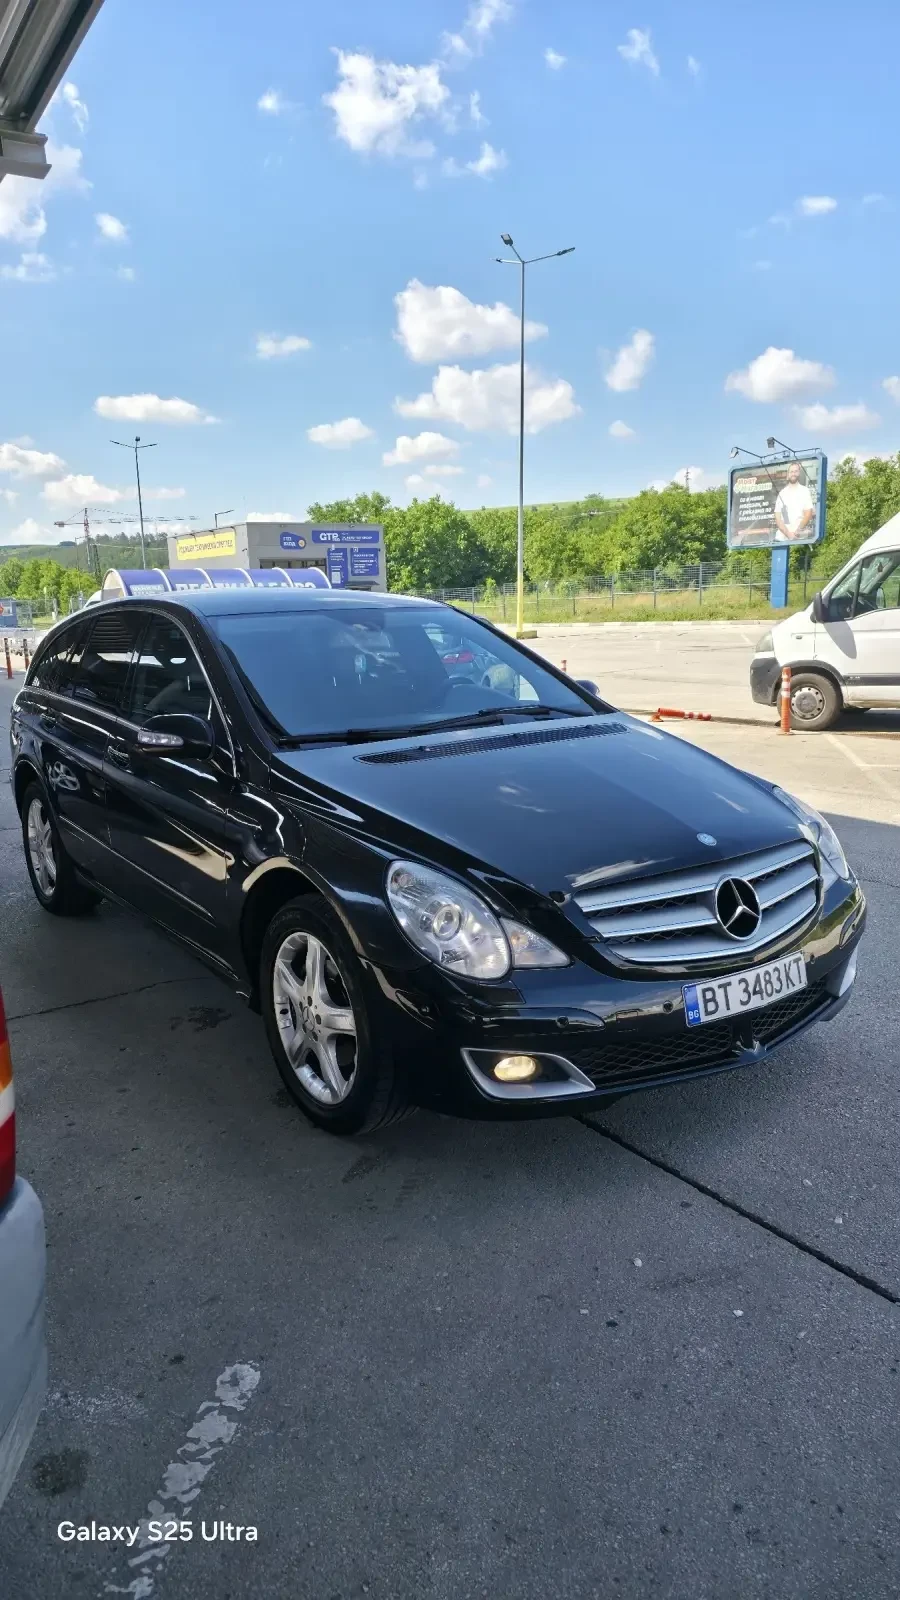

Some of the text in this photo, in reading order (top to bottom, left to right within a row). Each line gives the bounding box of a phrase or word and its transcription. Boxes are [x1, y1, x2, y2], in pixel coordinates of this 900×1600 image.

[319, 532, 339, 541] GTP
[701, 981, 732, 1017] BT
[688, 1009, 699, 1020] BG
